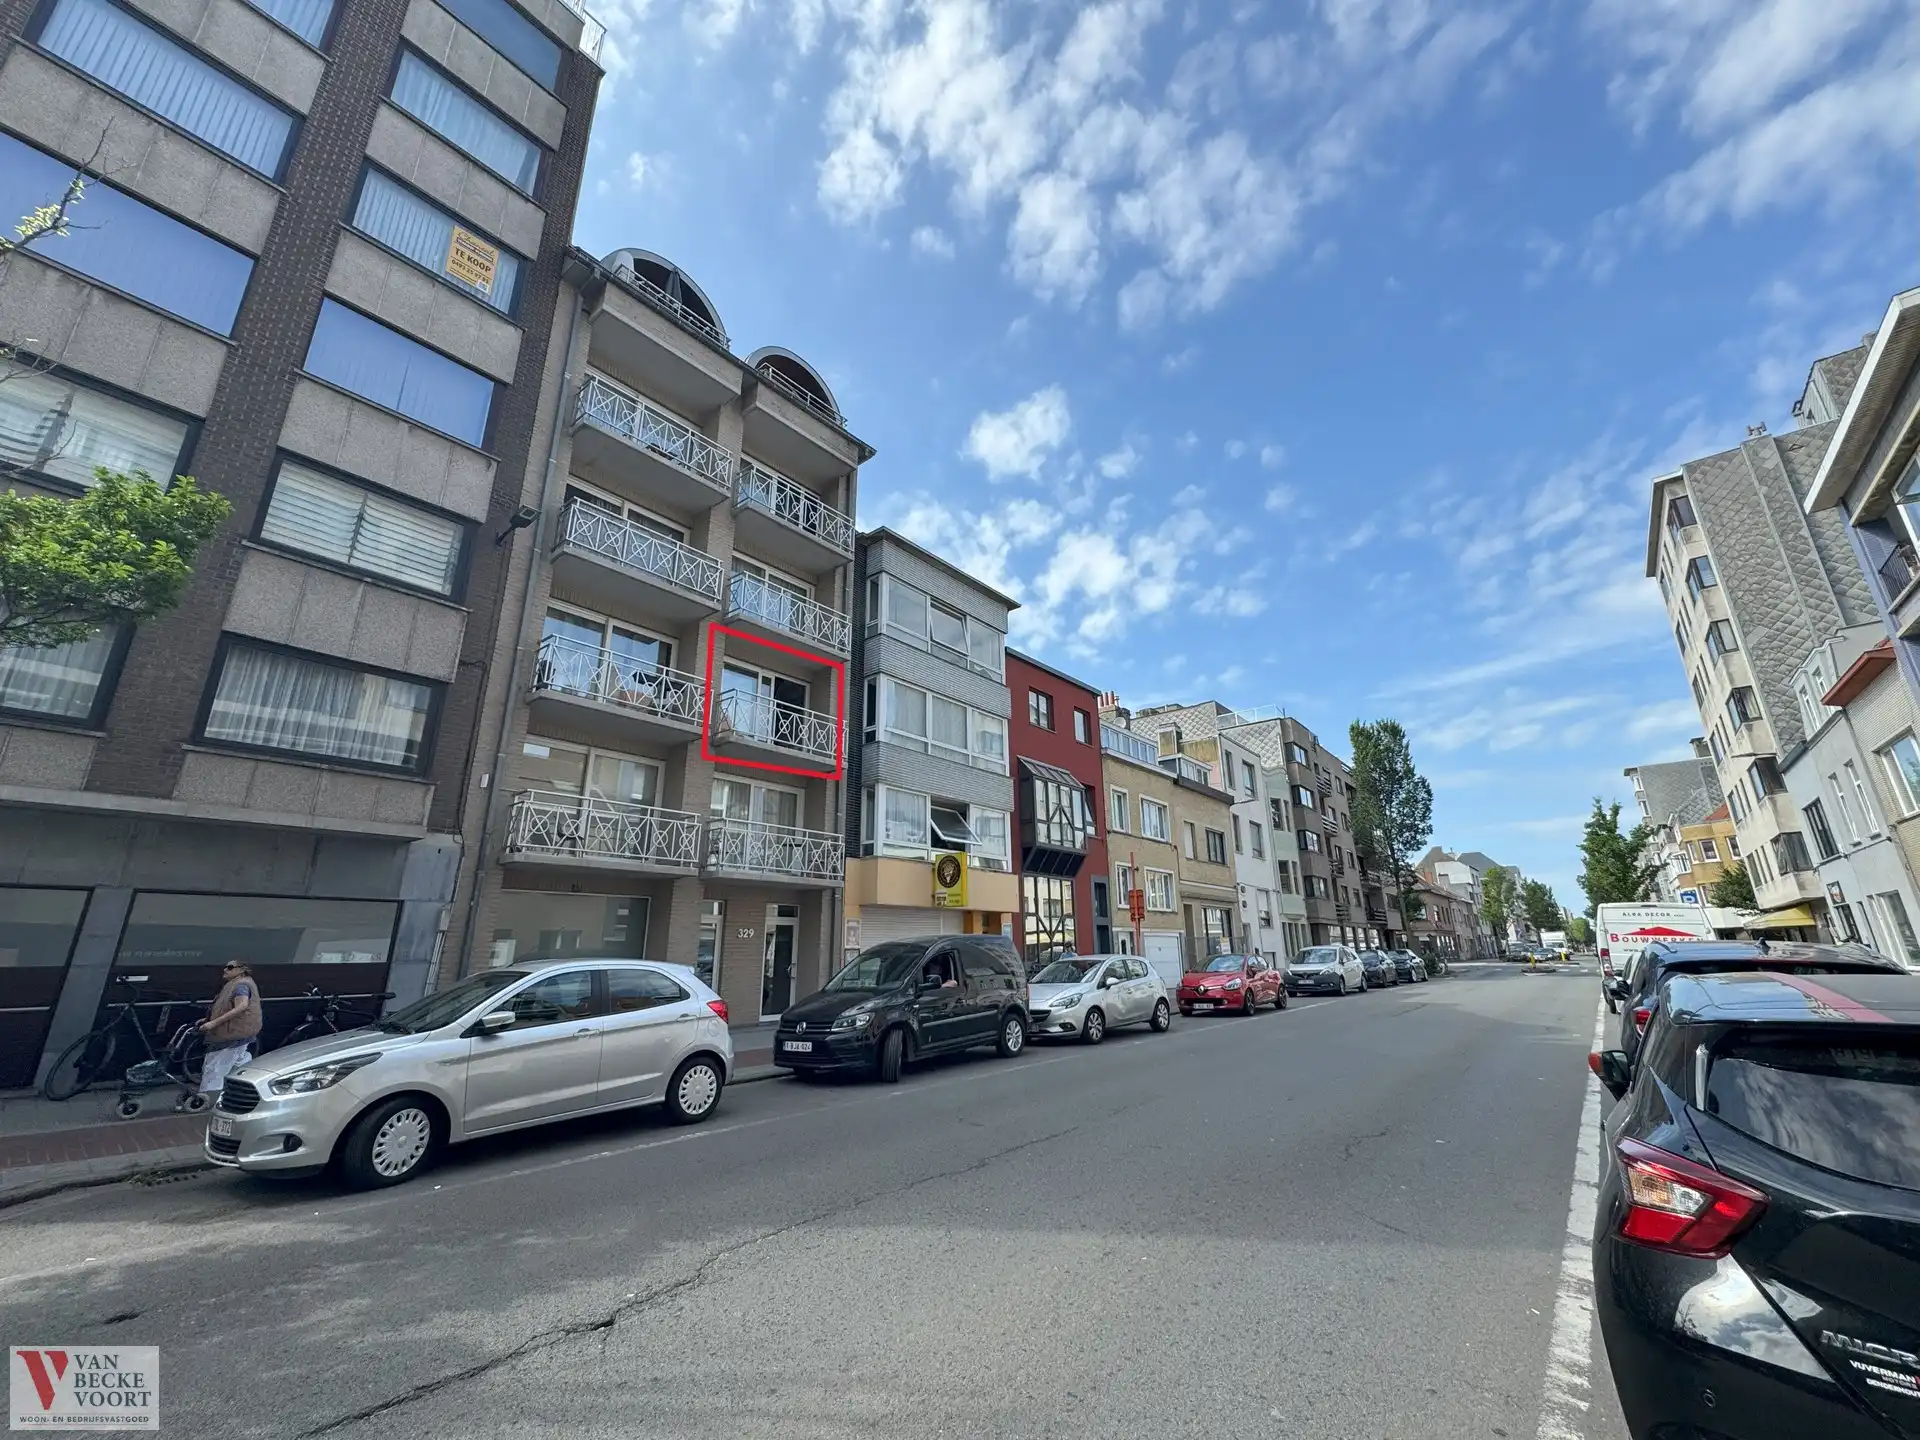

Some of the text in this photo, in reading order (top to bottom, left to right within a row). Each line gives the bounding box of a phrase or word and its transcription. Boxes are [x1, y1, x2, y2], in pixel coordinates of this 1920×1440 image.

[455, 248, 465, 259] TE
[467, 254, 491, 272] KOOP
[737, 928, 755, 938] 329
[1881, 1376, 1917, 1389] MOTORS
